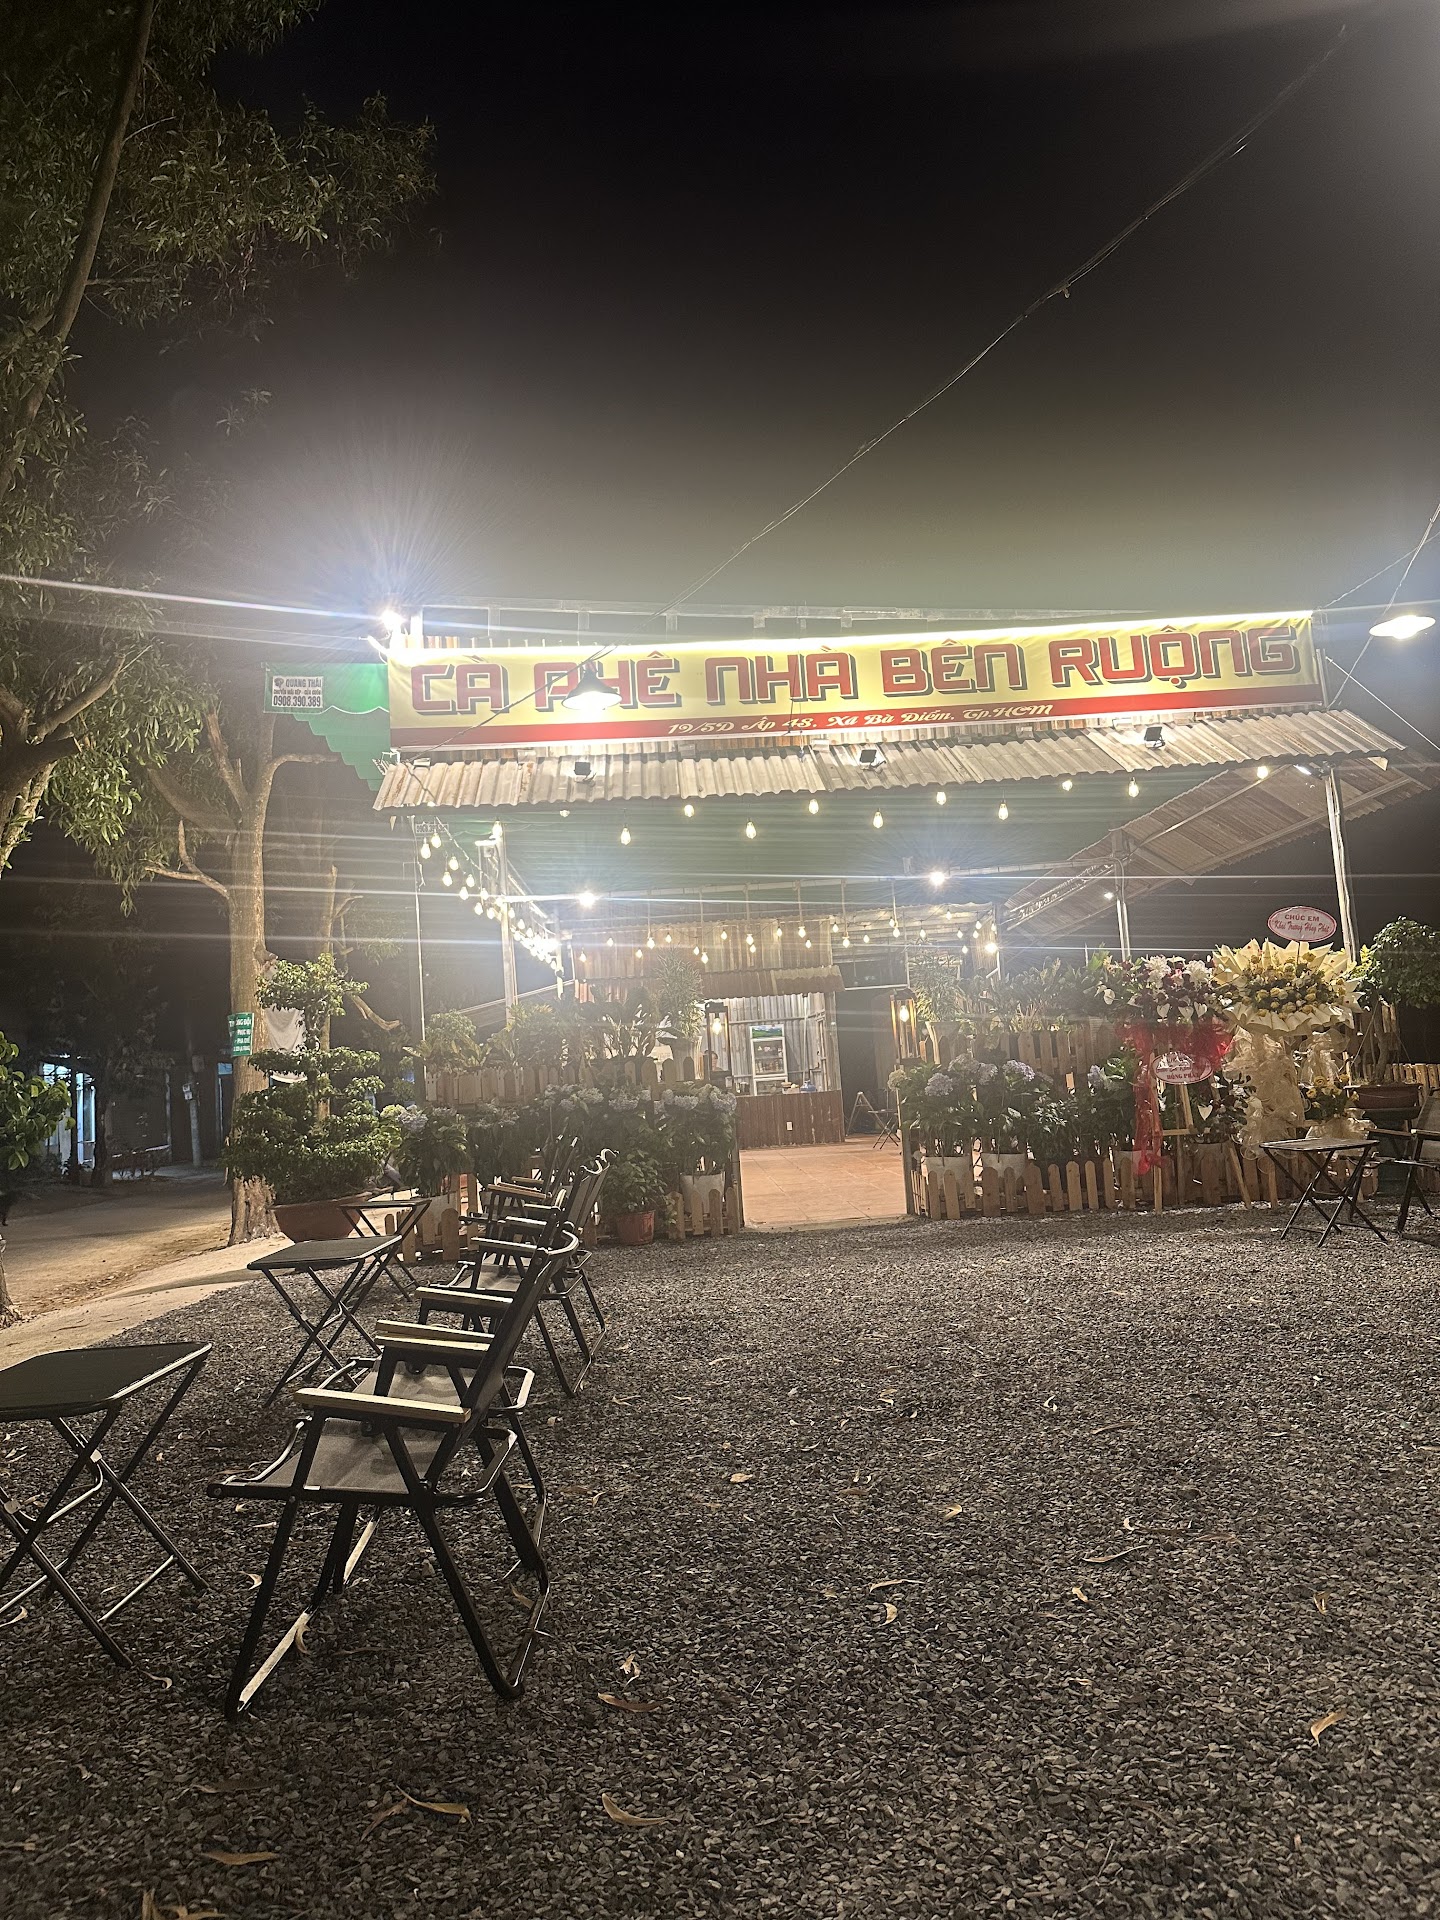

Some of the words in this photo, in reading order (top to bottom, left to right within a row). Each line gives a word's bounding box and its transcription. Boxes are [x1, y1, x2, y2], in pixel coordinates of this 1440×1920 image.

[411, 654, 510, 716] CÀ
[533, 650, 681, 712] PHÊ
[705, 645, 859, 706] NHÀ
[880, 638, 1028, 698] BÊN
[1048, 624, 1302, 690] RUỘNG
[285, 678, 307, 688] QUANG
[667, 721, 735, 735] 19/5D
[863, 713, 896, 726] Bà
[1284, 913, 1306, 921] CHÚC
